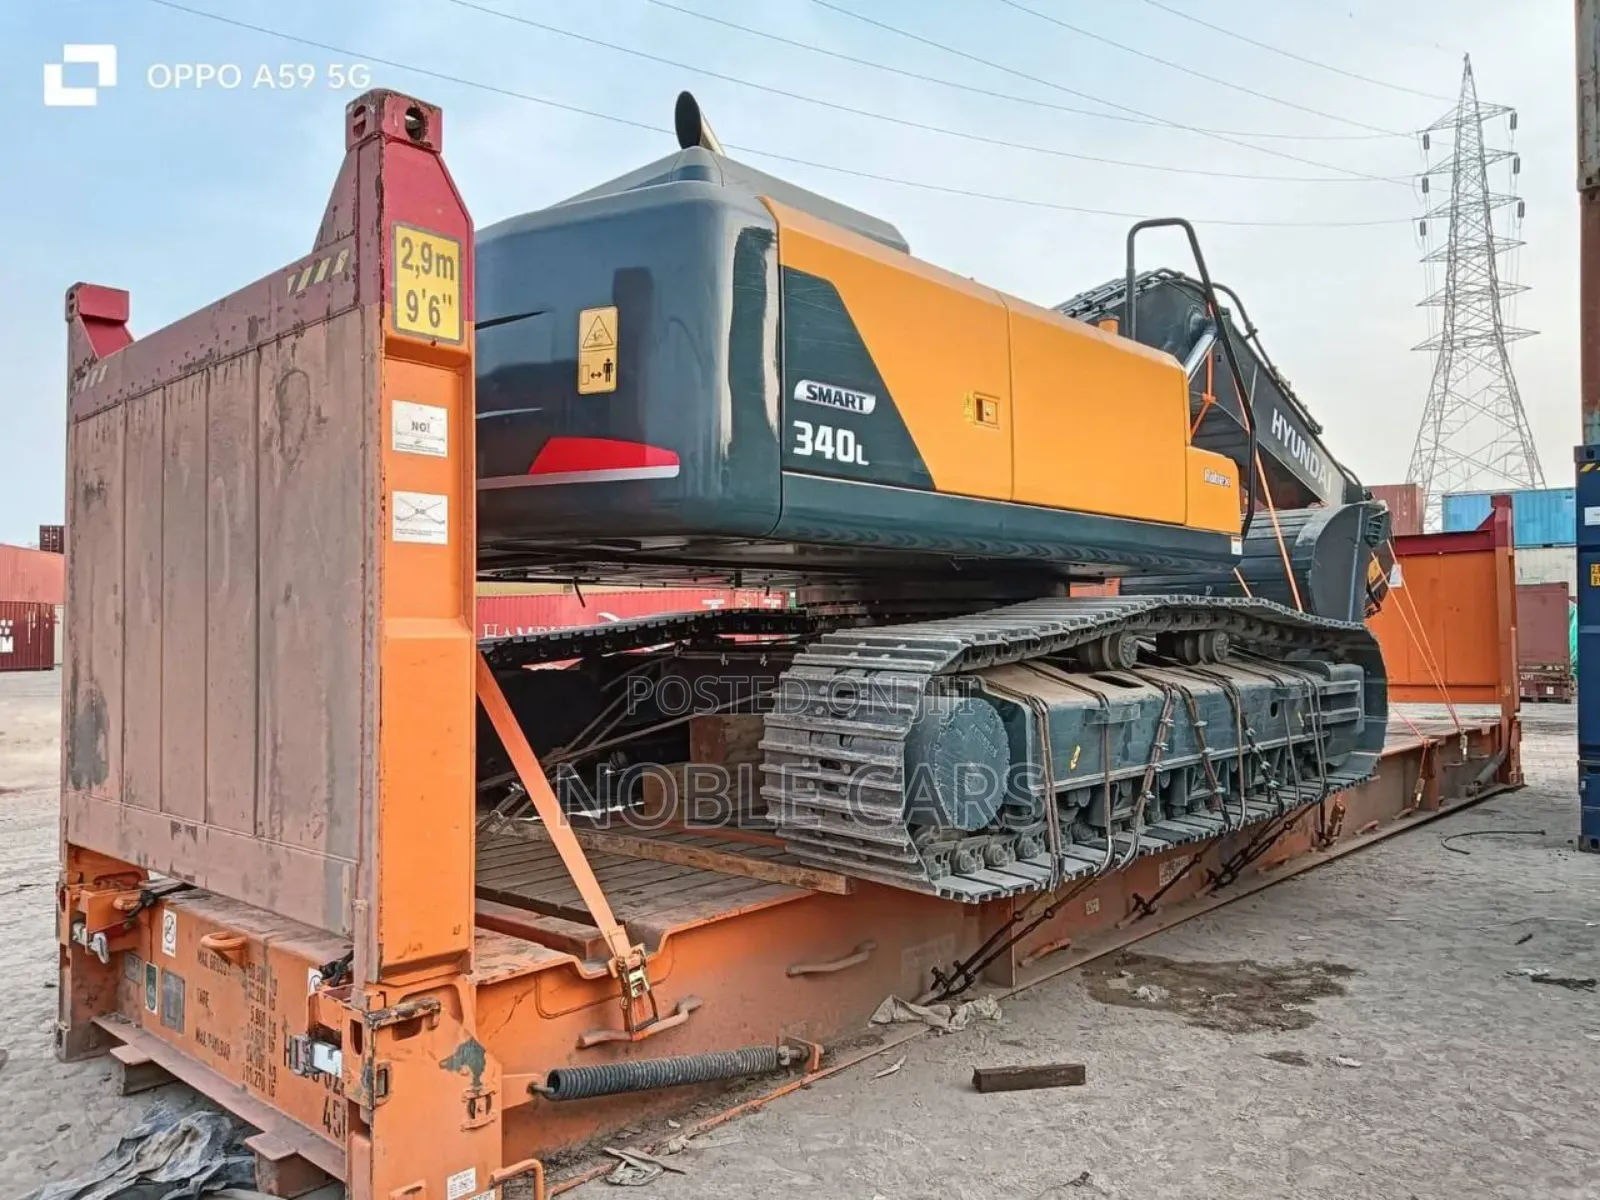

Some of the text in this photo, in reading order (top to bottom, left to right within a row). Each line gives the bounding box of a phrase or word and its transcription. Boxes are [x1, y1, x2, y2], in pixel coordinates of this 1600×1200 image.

[401, 236, 455, 281] 2,9m
[406, 288, 453, 329] 9'6"
[805, 383, 867, 411] SMART
[793, 420, 870, 466] 340L
[1271, 407, 1333, 496] HYUNDAI
